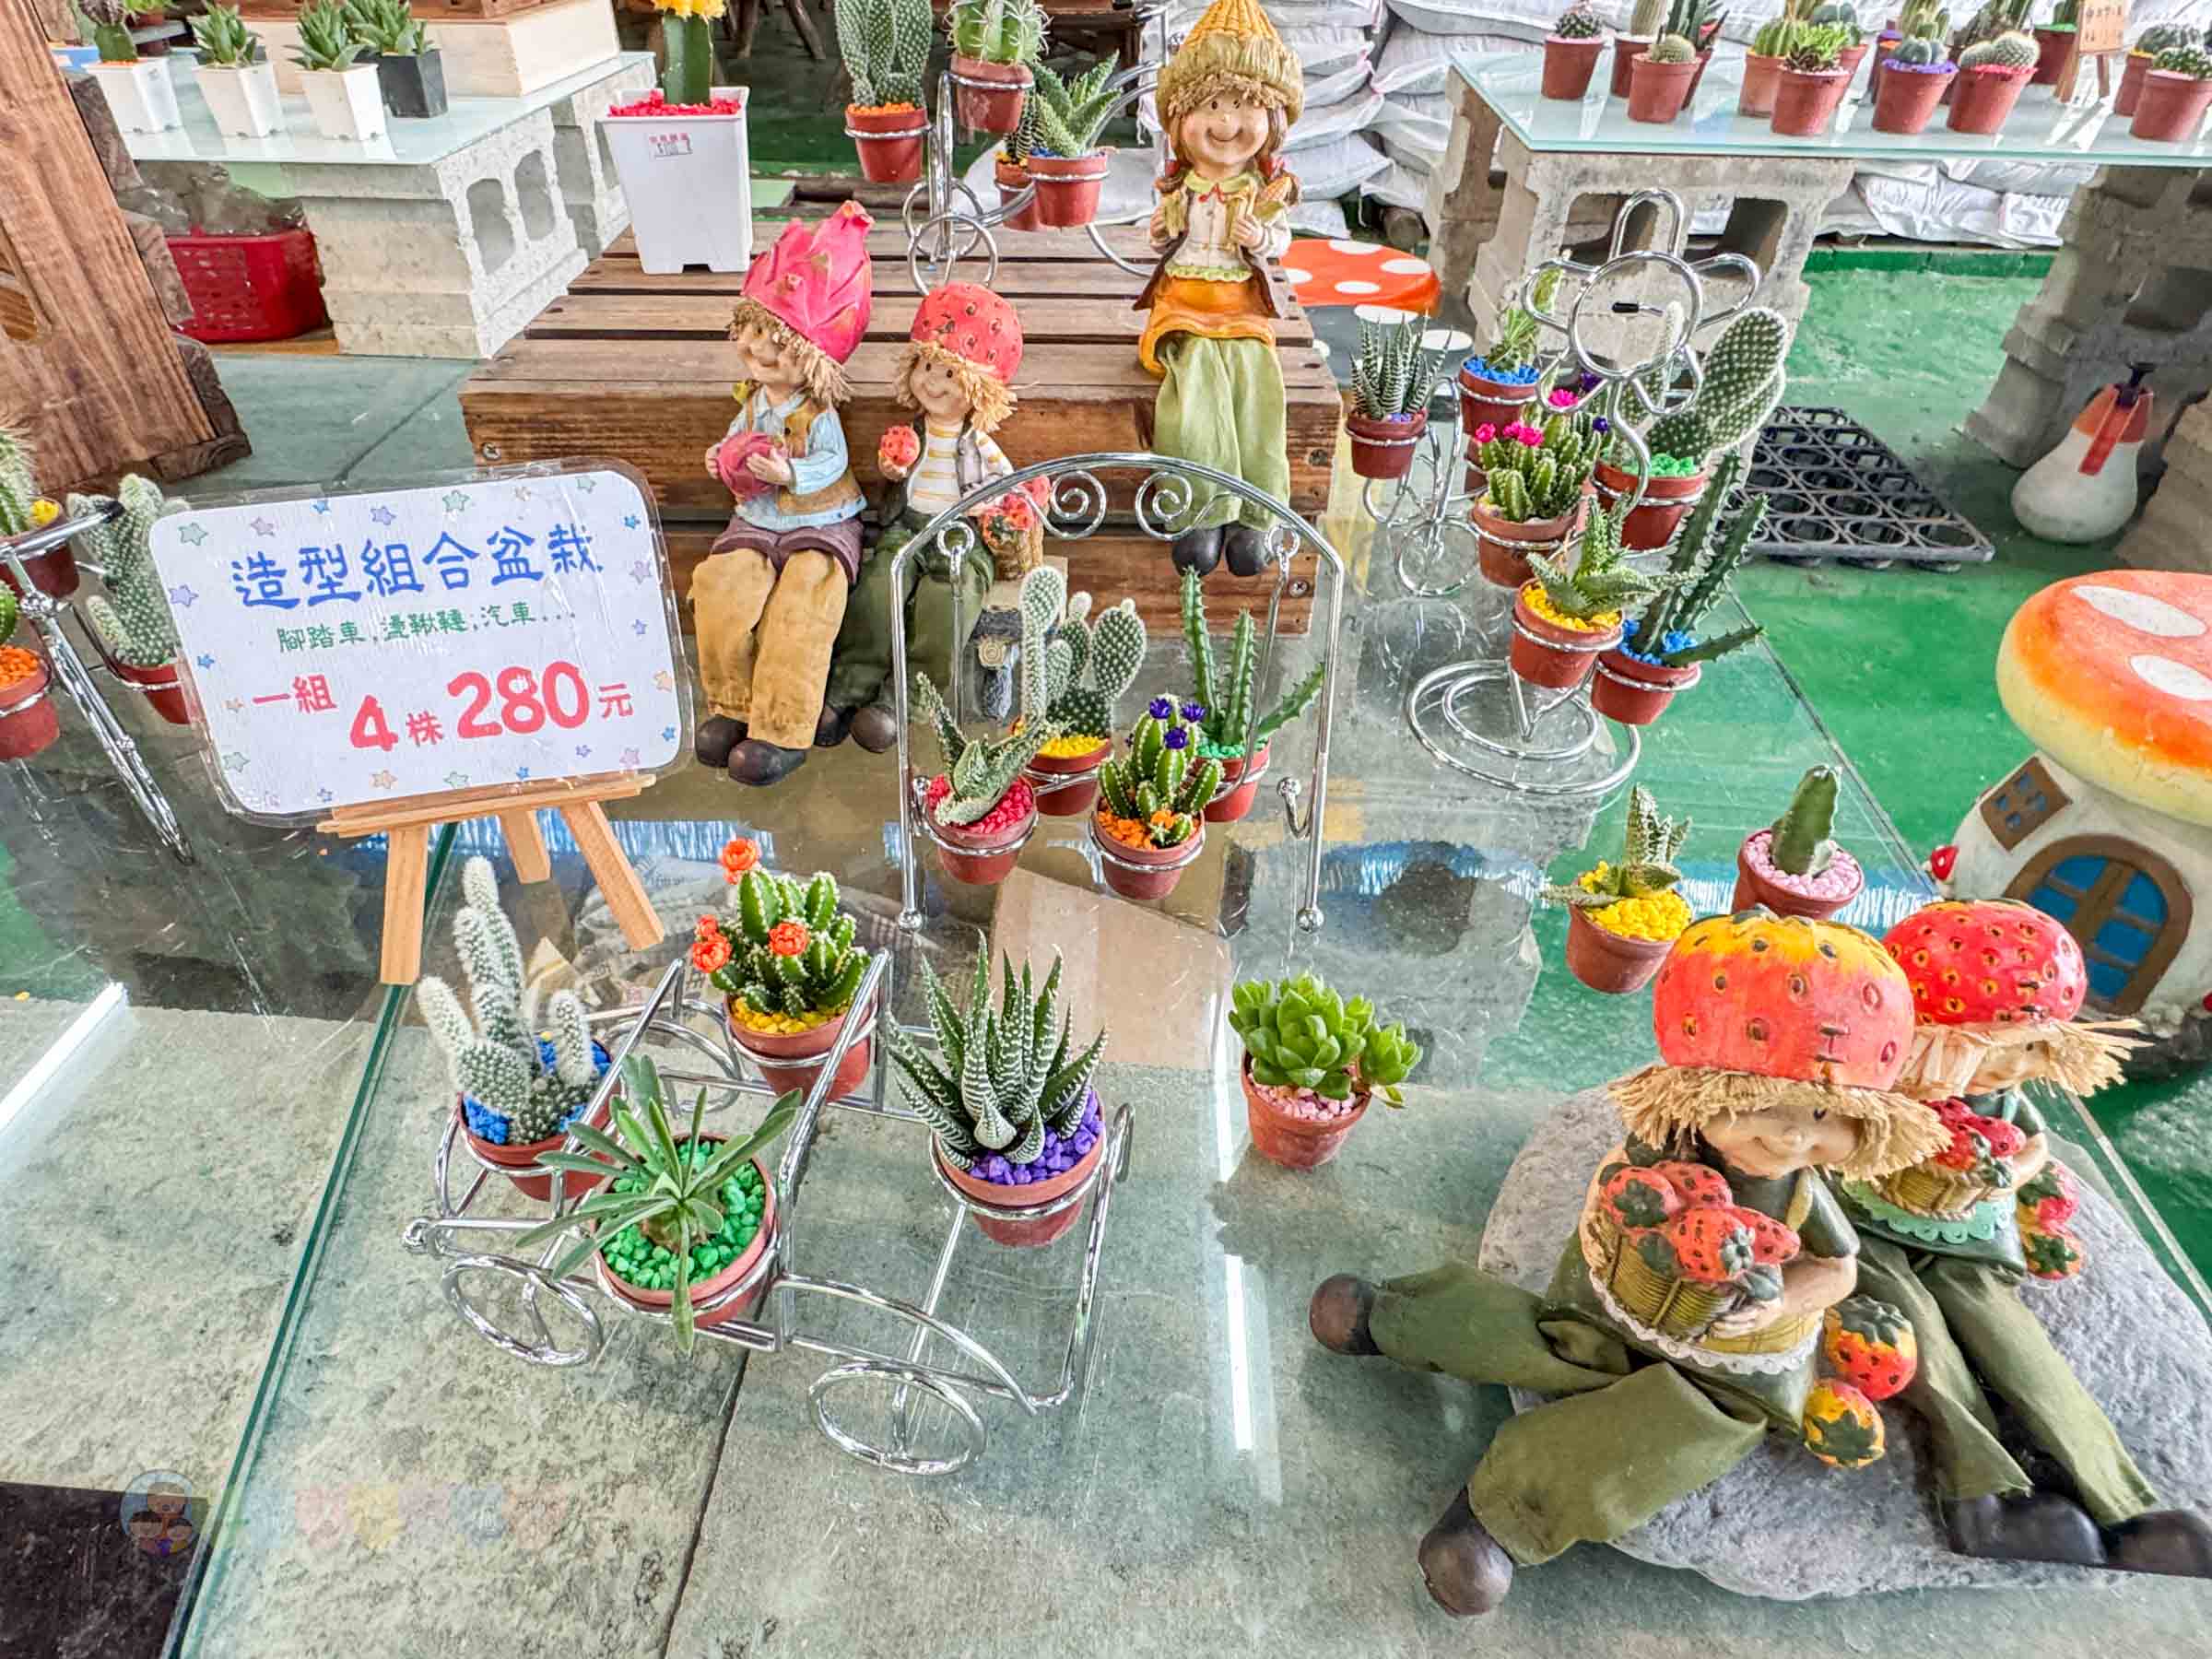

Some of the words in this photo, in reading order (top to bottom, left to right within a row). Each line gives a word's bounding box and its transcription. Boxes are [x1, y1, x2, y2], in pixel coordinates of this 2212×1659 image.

[230, 523, 604, 610] 造型組合盆栽
